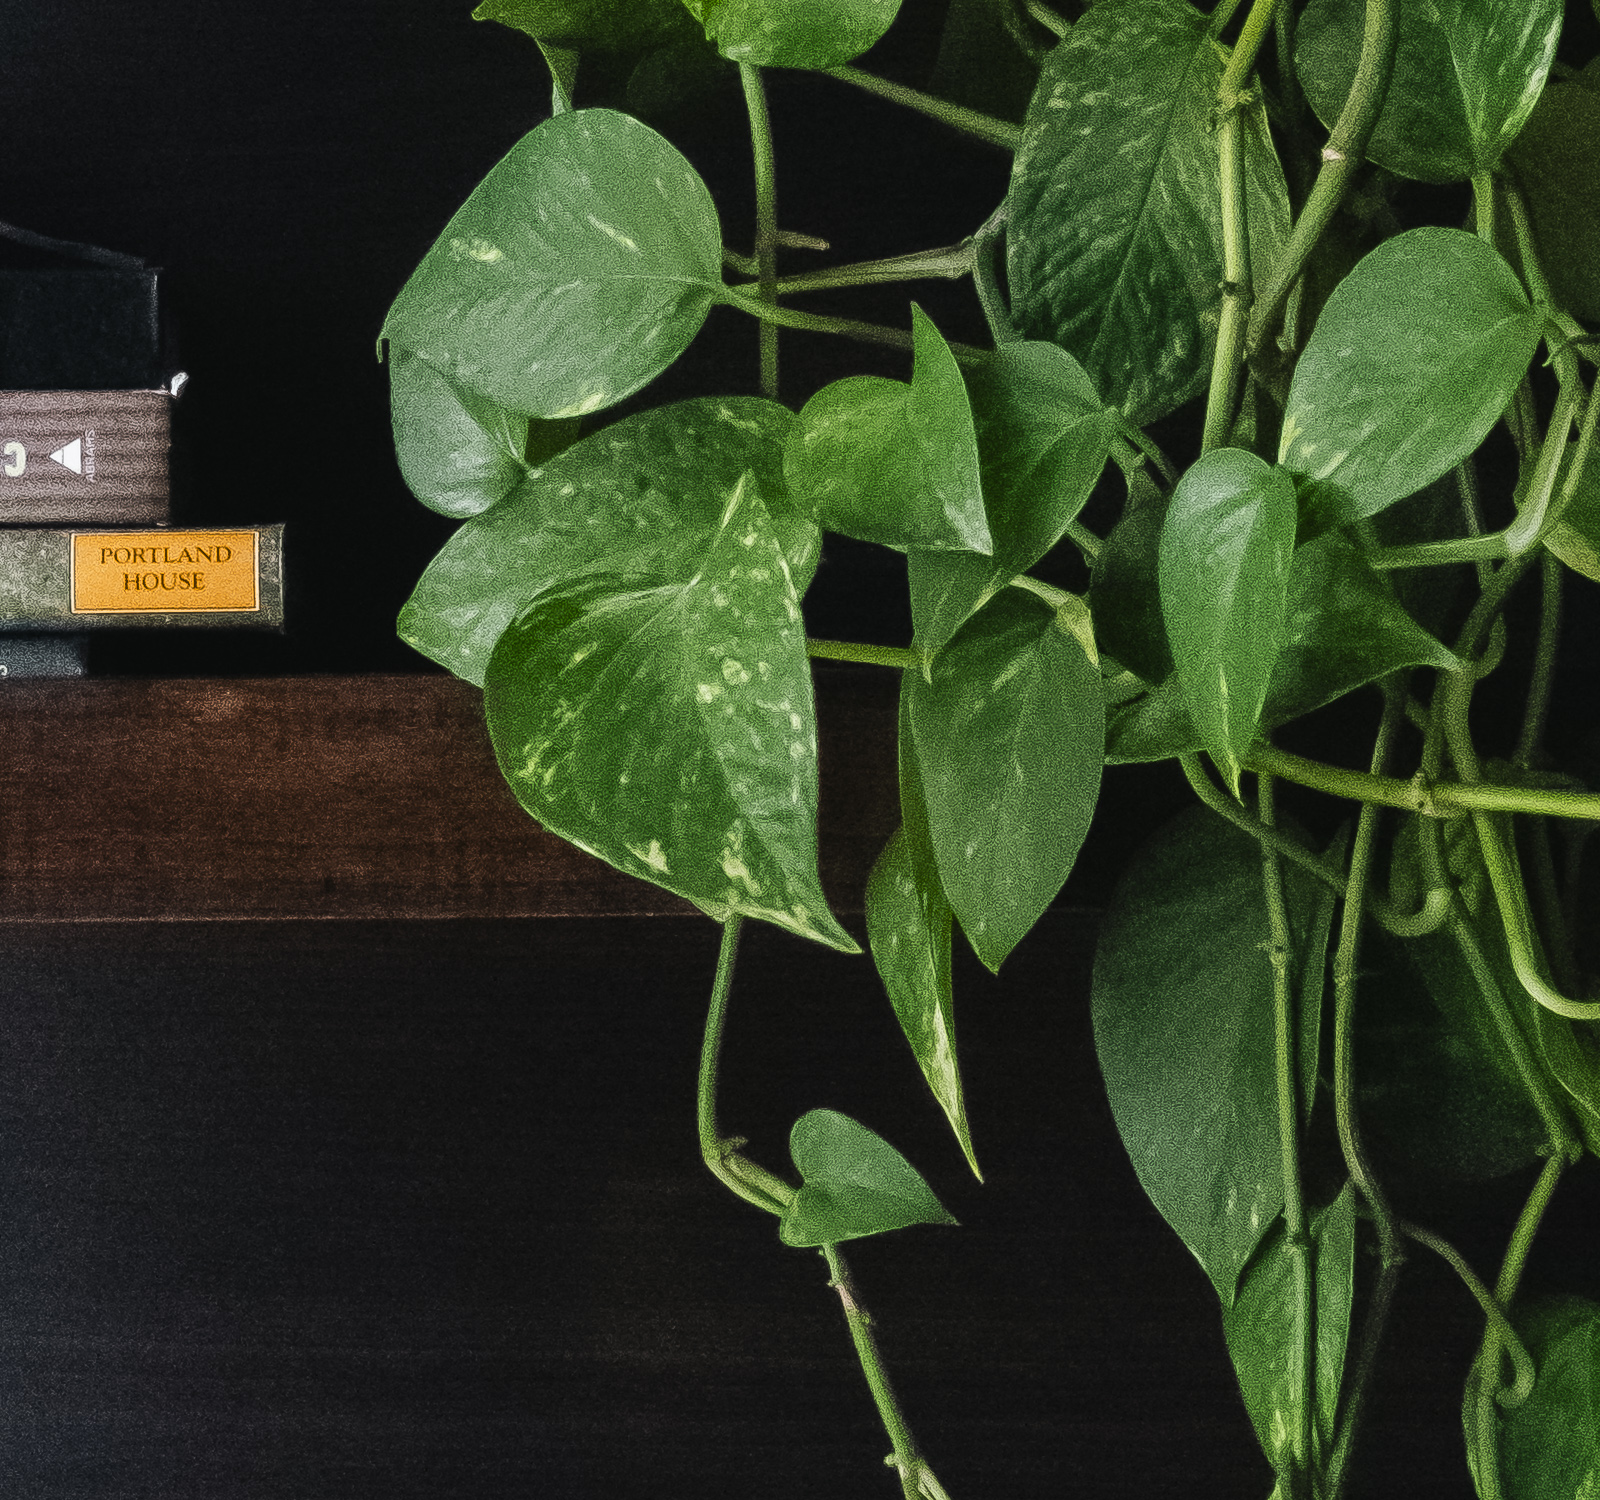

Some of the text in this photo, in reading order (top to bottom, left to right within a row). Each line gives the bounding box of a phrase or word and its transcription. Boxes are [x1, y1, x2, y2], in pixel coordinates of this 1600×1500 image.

[83, 429, 96, 482] ABRAMS
[100, 545, 232, 565] PORTLAND
[123, 571, 206, 591] HOUSE
